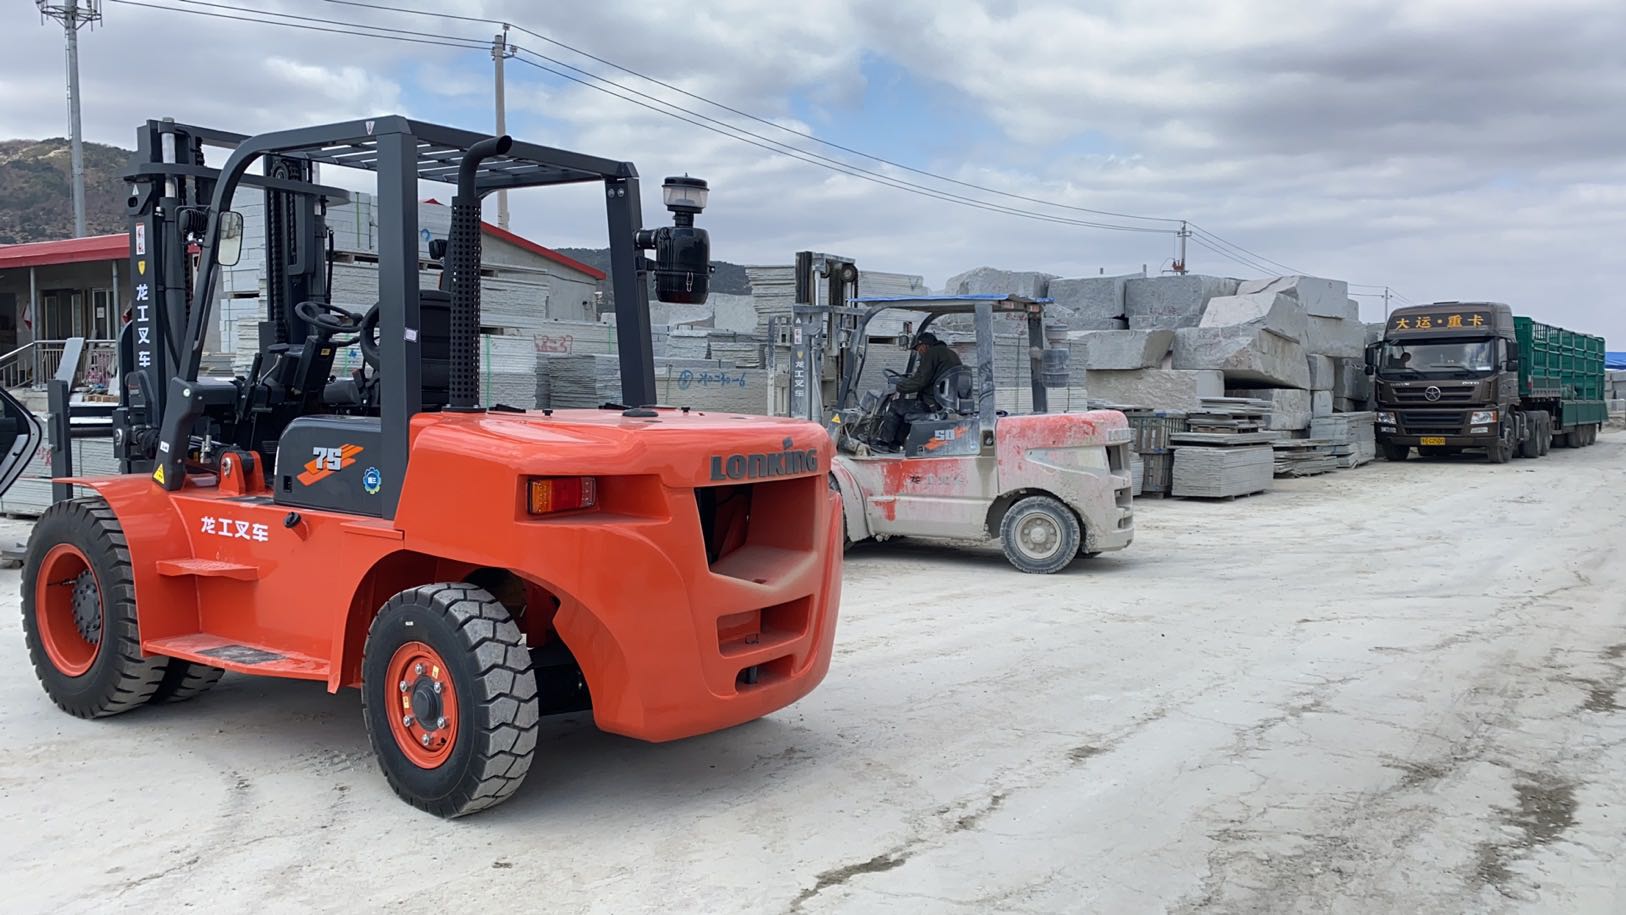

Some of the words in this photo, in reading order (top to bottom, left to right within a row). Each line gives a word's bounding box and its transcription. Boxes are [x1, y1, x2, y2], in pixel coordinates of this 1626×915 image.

[136, 284, 150, 367] 龙工叉车
[1396, 314, 1484, 331] 大运·重卡
[794, 361, 805, 397] 龙工叉车
[313, 447, 342, 471] 75
[710, 436, 818, 481] LONKING
[200, 516, 269, 541] 龙工叉车
